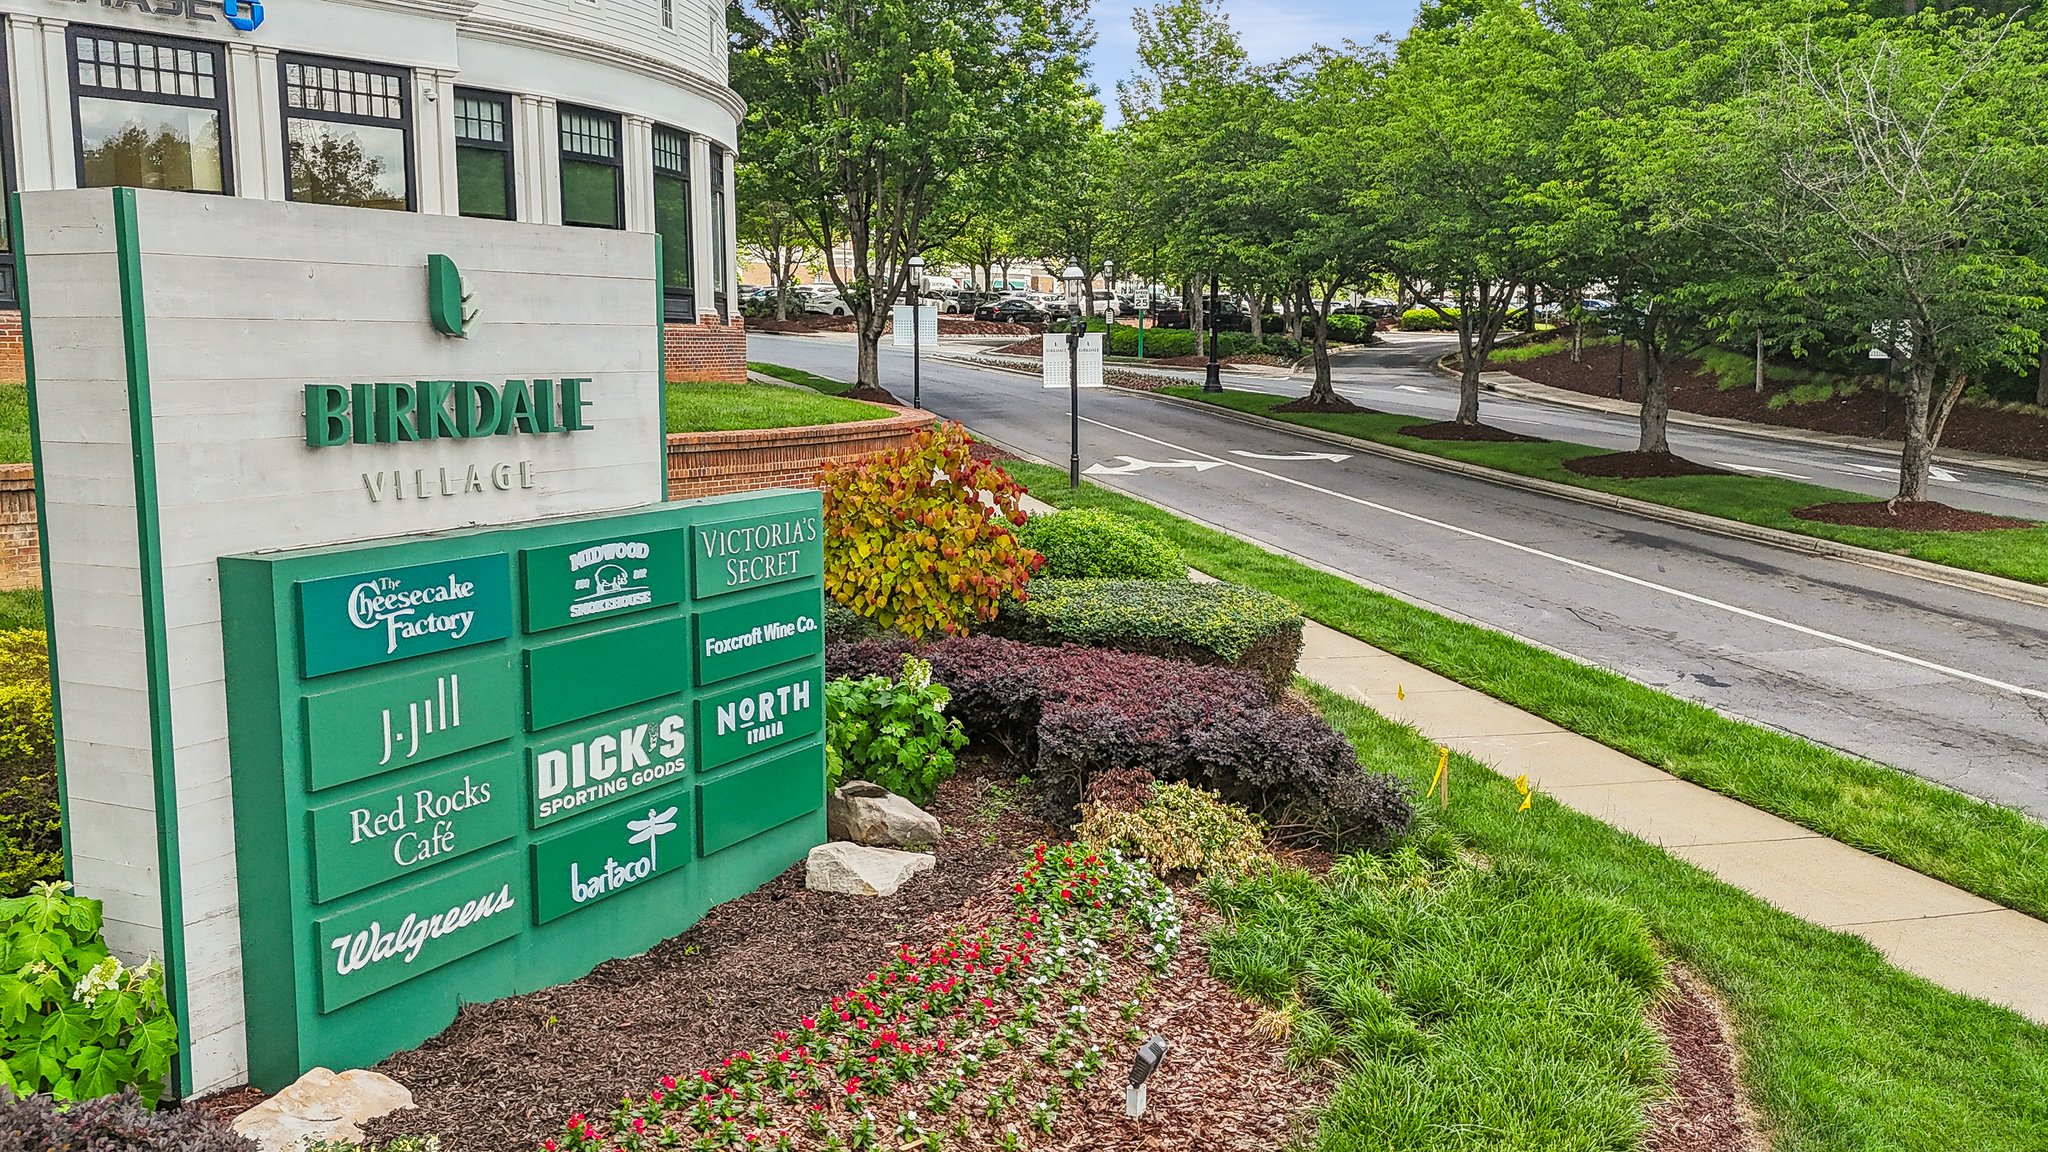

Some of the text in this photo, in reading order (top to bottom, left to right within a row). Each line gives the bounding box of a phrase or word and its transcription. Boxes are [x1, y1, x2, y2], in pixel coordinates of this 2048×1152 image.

[1136, 299, 1148, 307] 25
[304, 377, 595, 448] BIRKDALE
[362, 459, 536, 502] VILLAGE
[569, 541, 650, 572] MIDWOOD
[701, 516, 817, 559] VICTORIA'S
[378, 576, 401, 591] The
[726, 550, 800, 587] SECRET
[347, 573, 475, 629] Cheesecake
[569, 590, 652, 618] SMOKEHOUSE
[375, 608, 475, 655] Factory
[705, 615, 818, 657] Foxcroft Wine Co.
[716, 680, 810, 737] NORTH
[747, 720, 784, 746] ITALIA
[537, 714, 685, 800] DICK'S
[349, 775, 492, 845] Red Rocks
[539, 757, 686, 819] SPORTING GOODS
[393, 821, 456, 866] Café
[571, 856, 651, 903] bartaco
[331, 884, 516, 976] Walgreens
